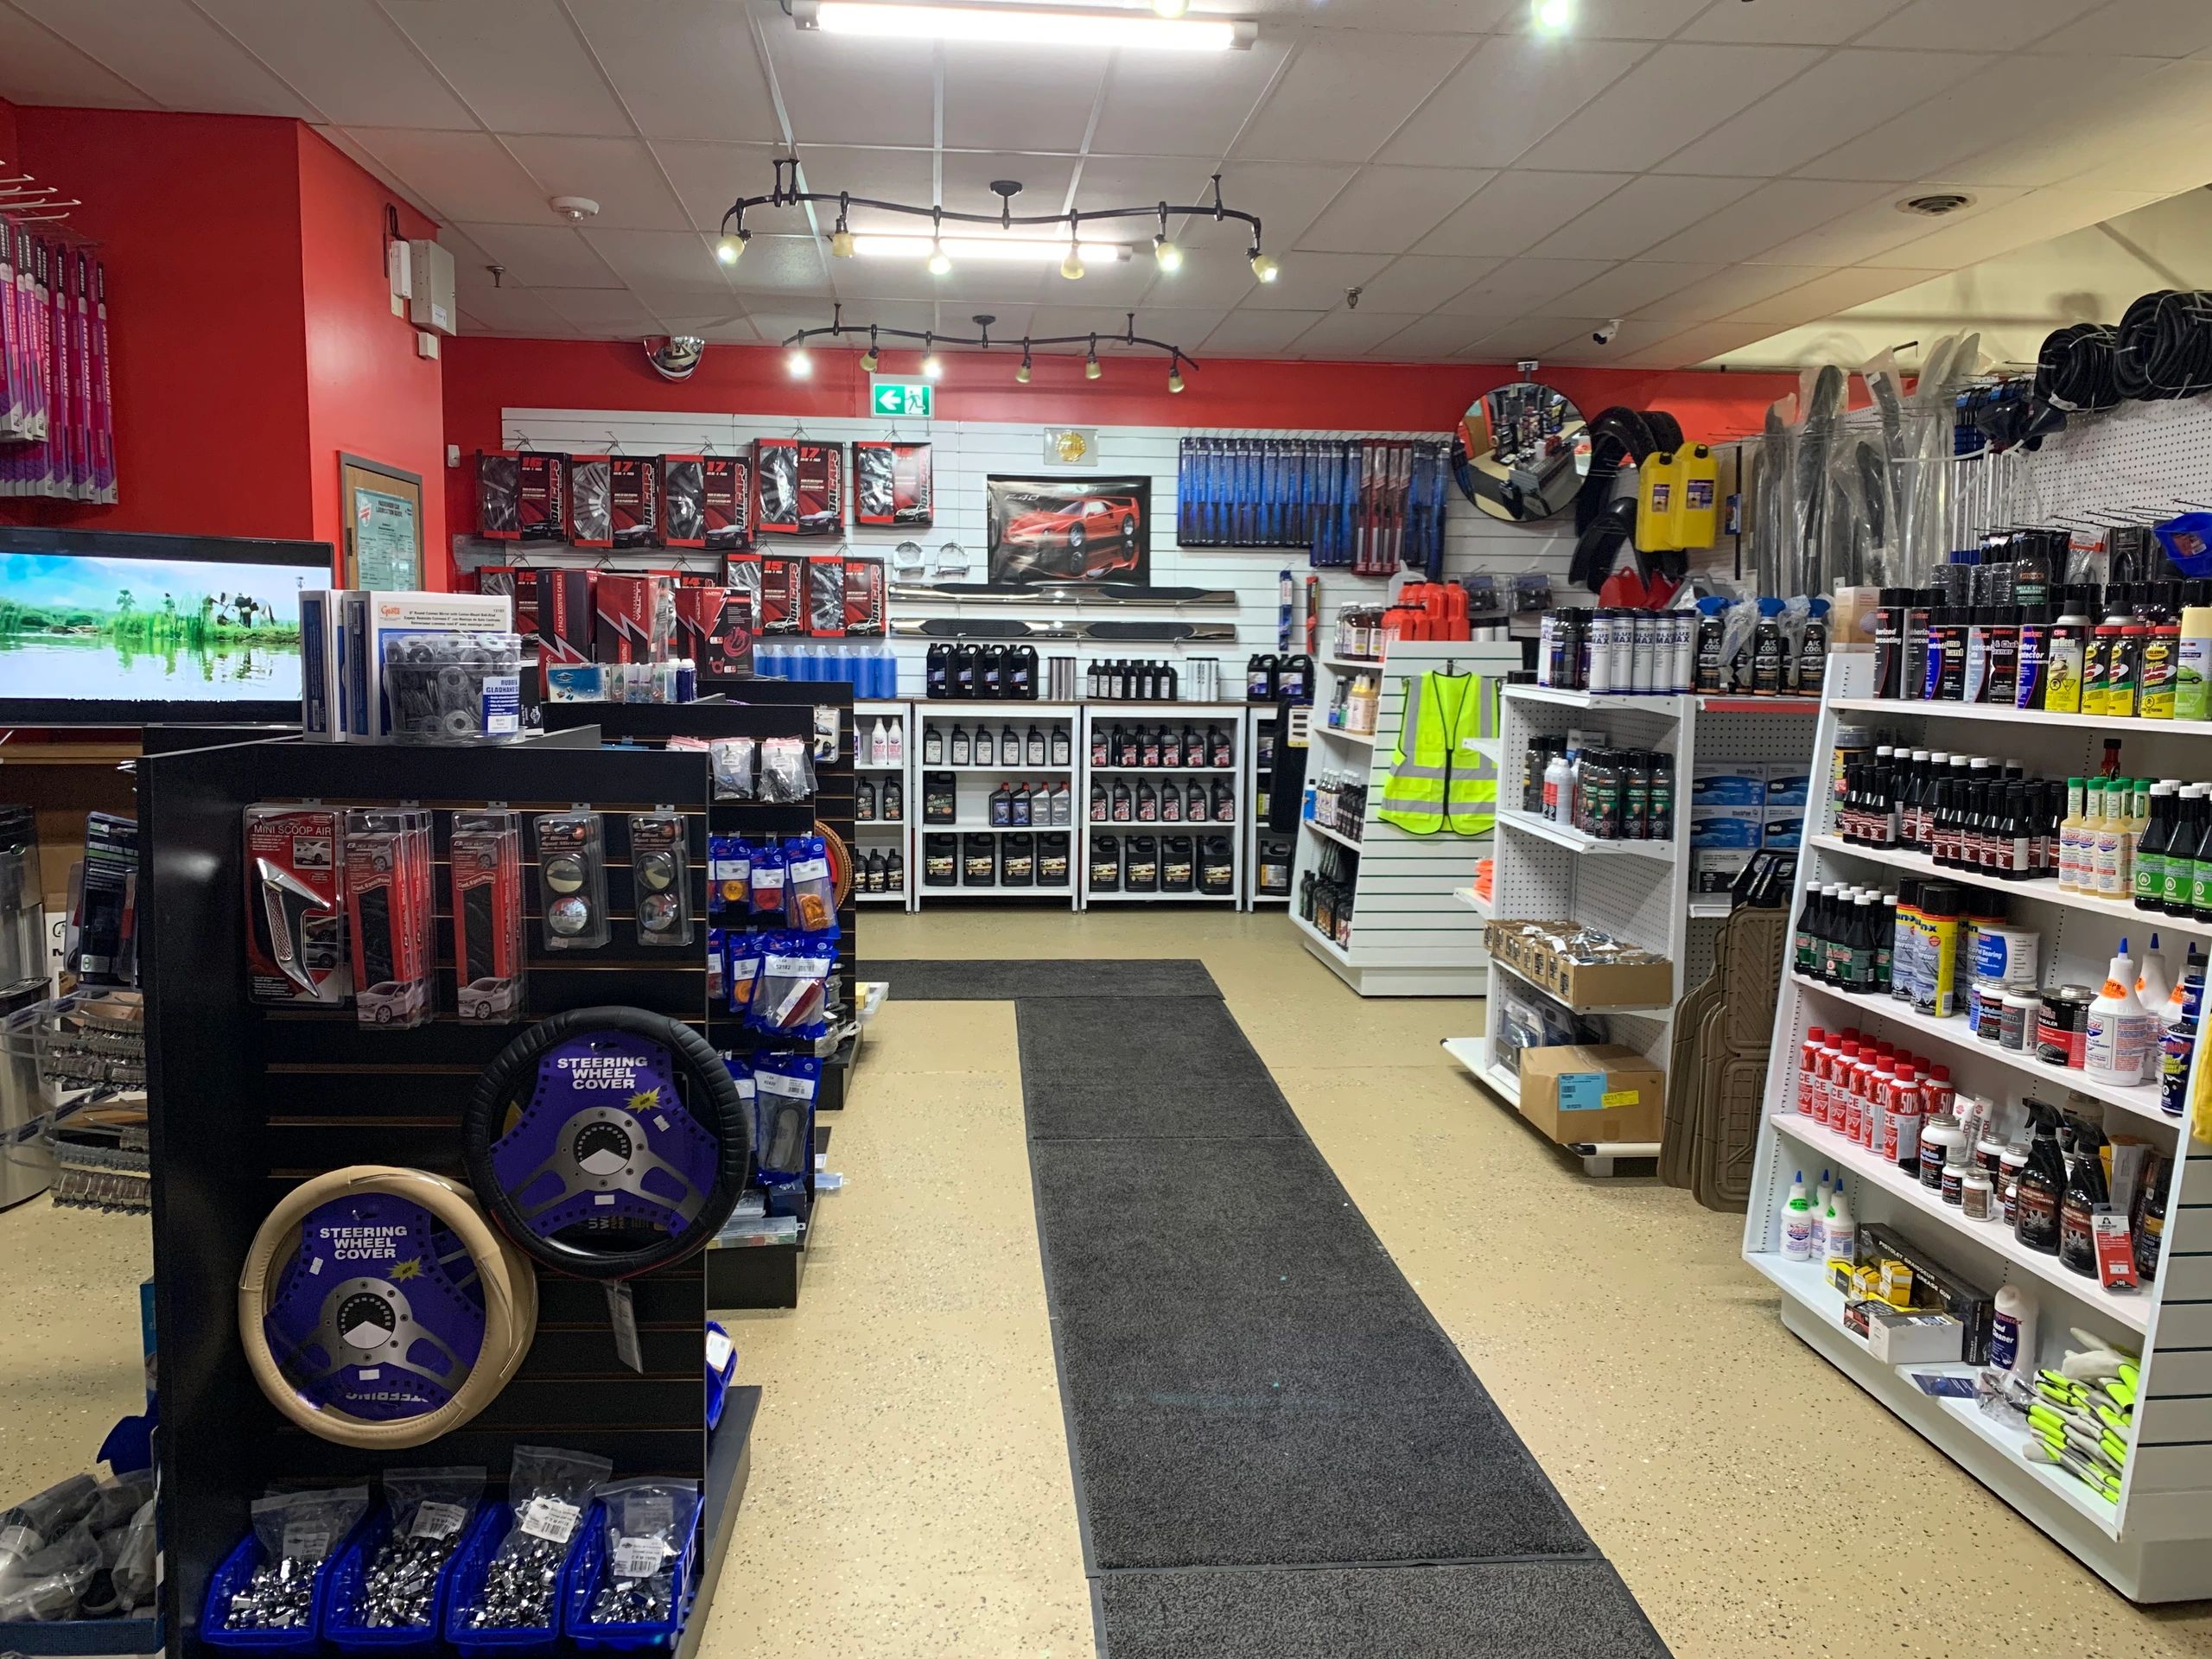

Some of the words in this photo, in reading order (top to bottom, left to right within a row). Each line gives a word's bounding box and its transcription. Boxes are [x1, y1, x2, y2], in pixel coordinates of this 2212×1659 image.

[253, 824, 276, 834] MINI
[277, 825, 313, 836] SCOOP
[315, 827, 332, 836] AIR
[557, 1057, 648, 1069] STEERING
[572, 1068, 637, 1079] WHEEL
[572, 1078, 635, 1090] COVER
[1901, 1091, 1920, 1114] 50%
[320, 1226, 408, 1238] STEERING
[334, 1237, 397, 1249] WHEEL
[334, 1249, 397, 1260] COVER
[1878, 1240, 1904, 1259] PISTOLET
[1904, 1257, 1936, 1281] GRAISSEUR
[1916, 1273, 1939, 1292] GREASE
[1939, 1289, 1952, 1300] GUN
